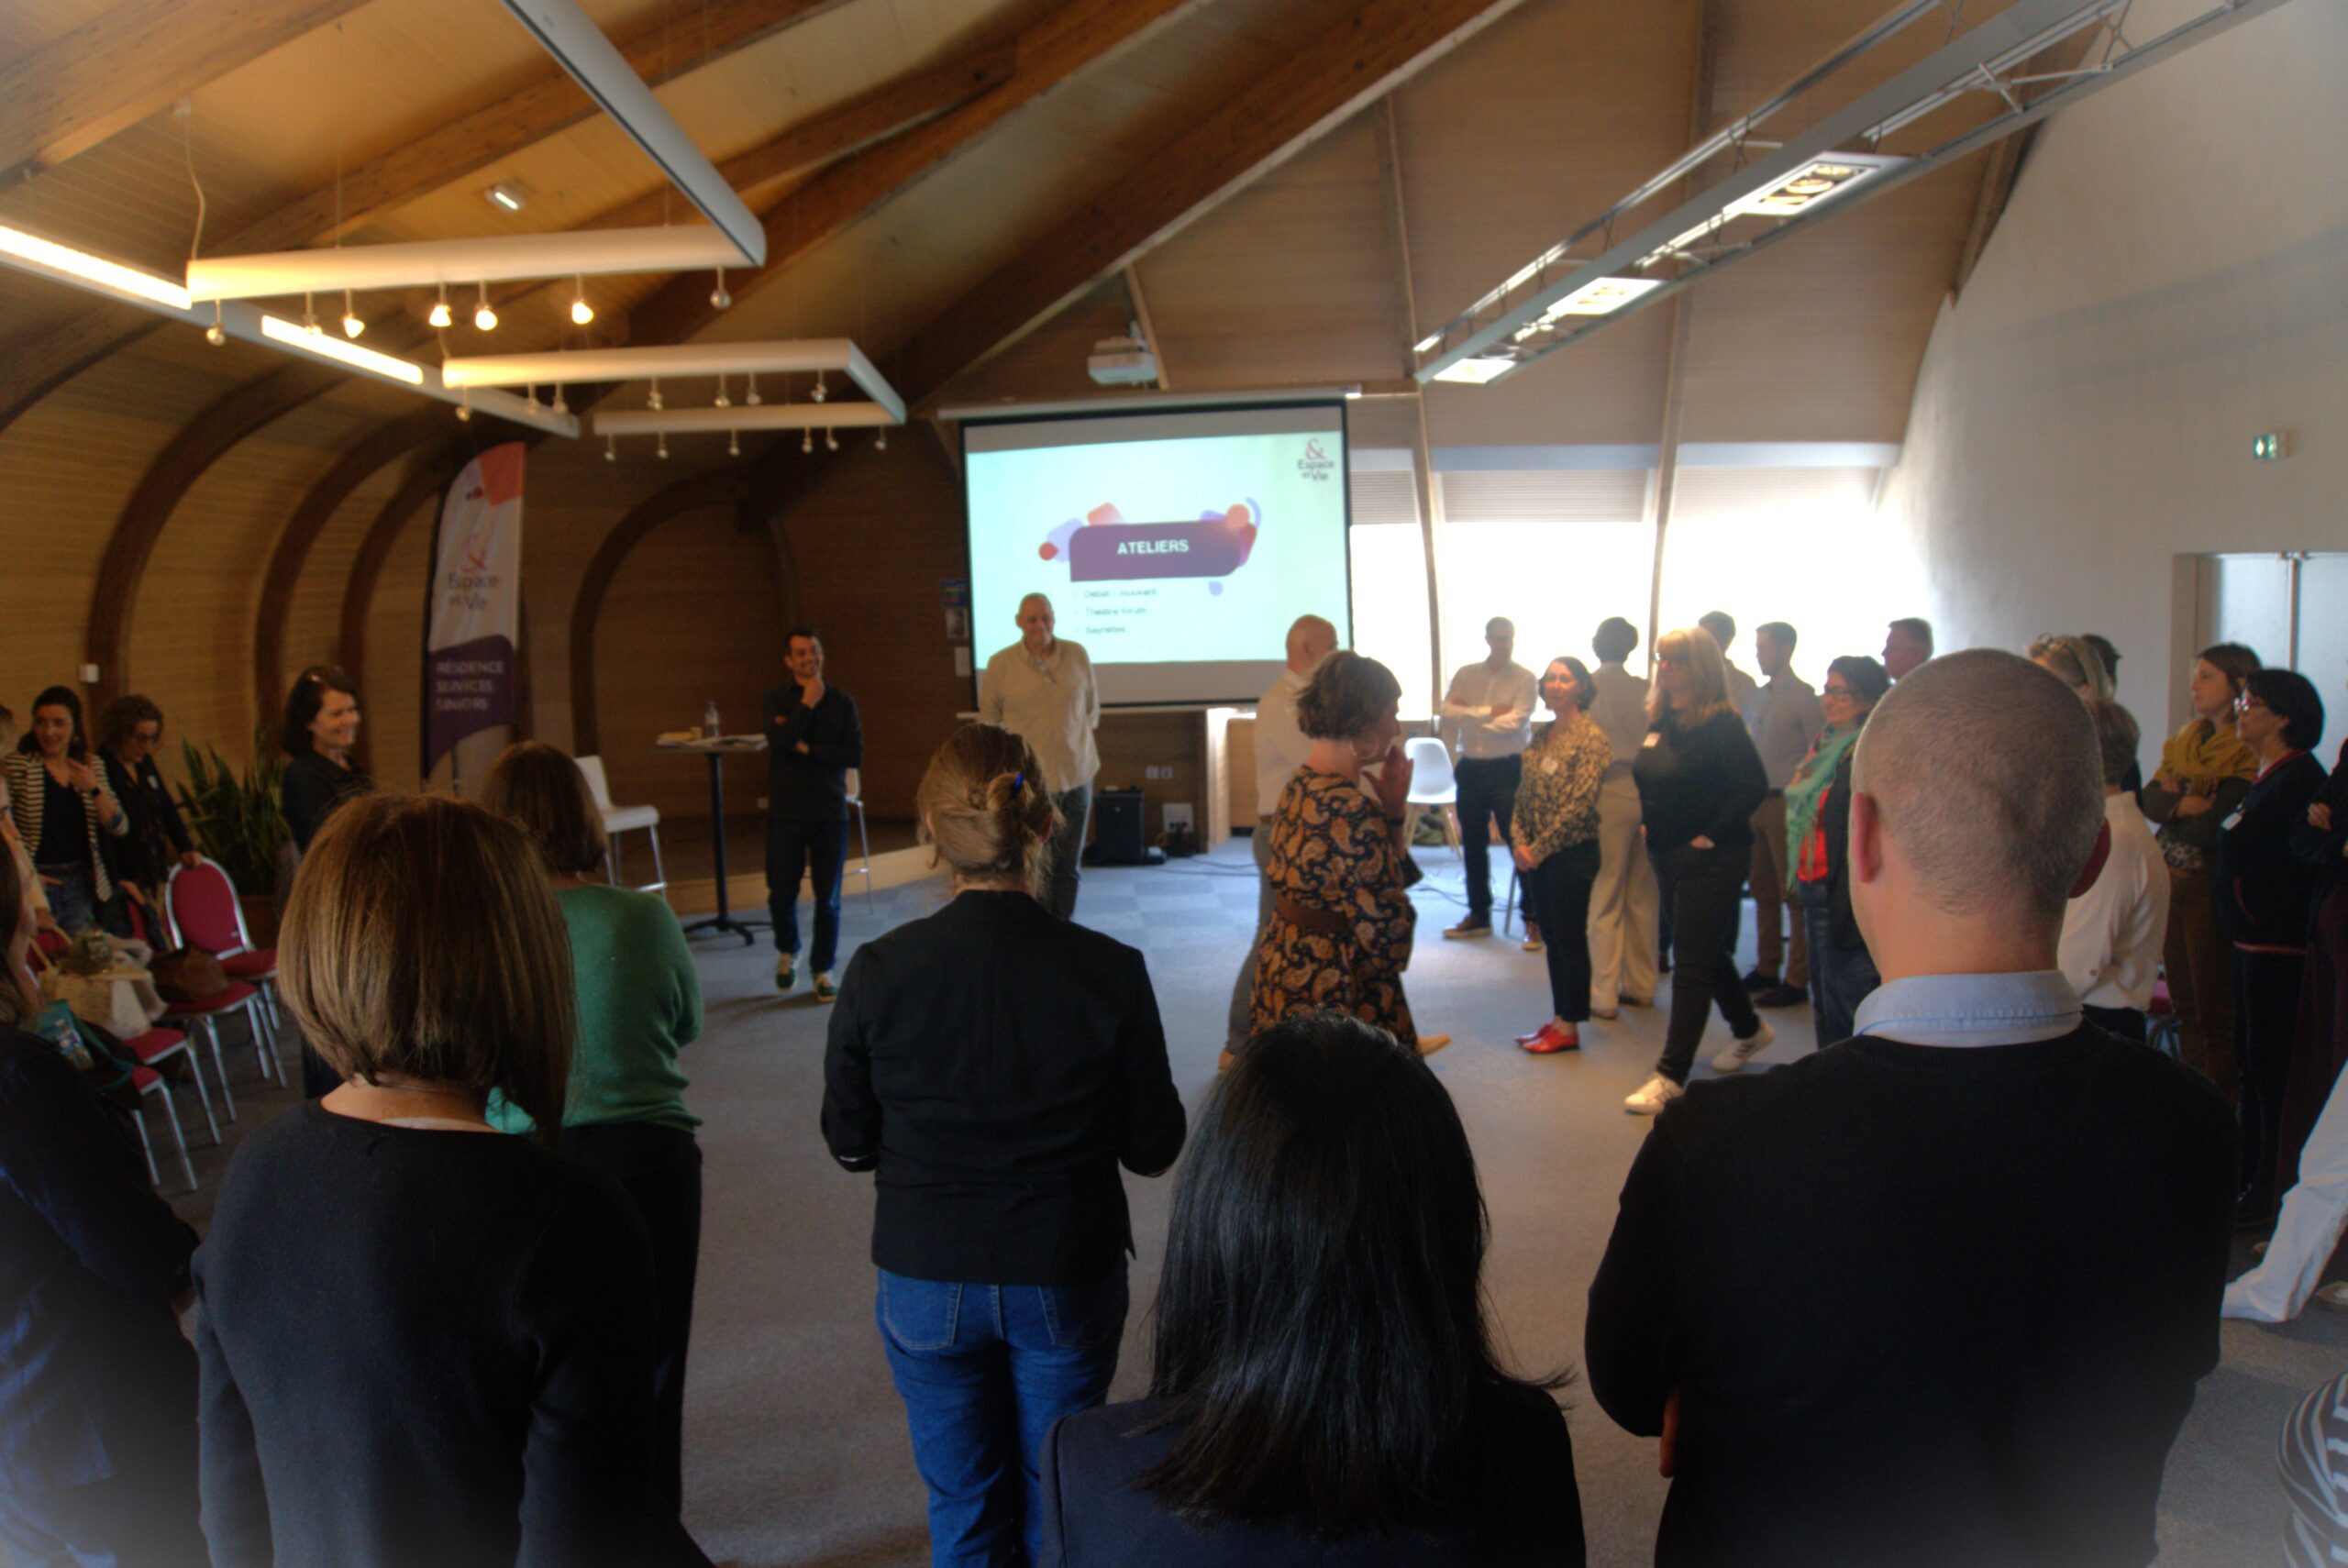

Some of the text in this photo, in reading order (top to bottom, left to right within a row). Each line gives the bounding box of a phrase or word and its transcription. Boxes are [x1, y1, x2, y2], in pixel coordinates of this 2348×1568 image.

[1298, 459, 1335, 471] Espace
[1117, 540, 1190, 555] ATELIERS
[448, 572, 499, 591] Espace
